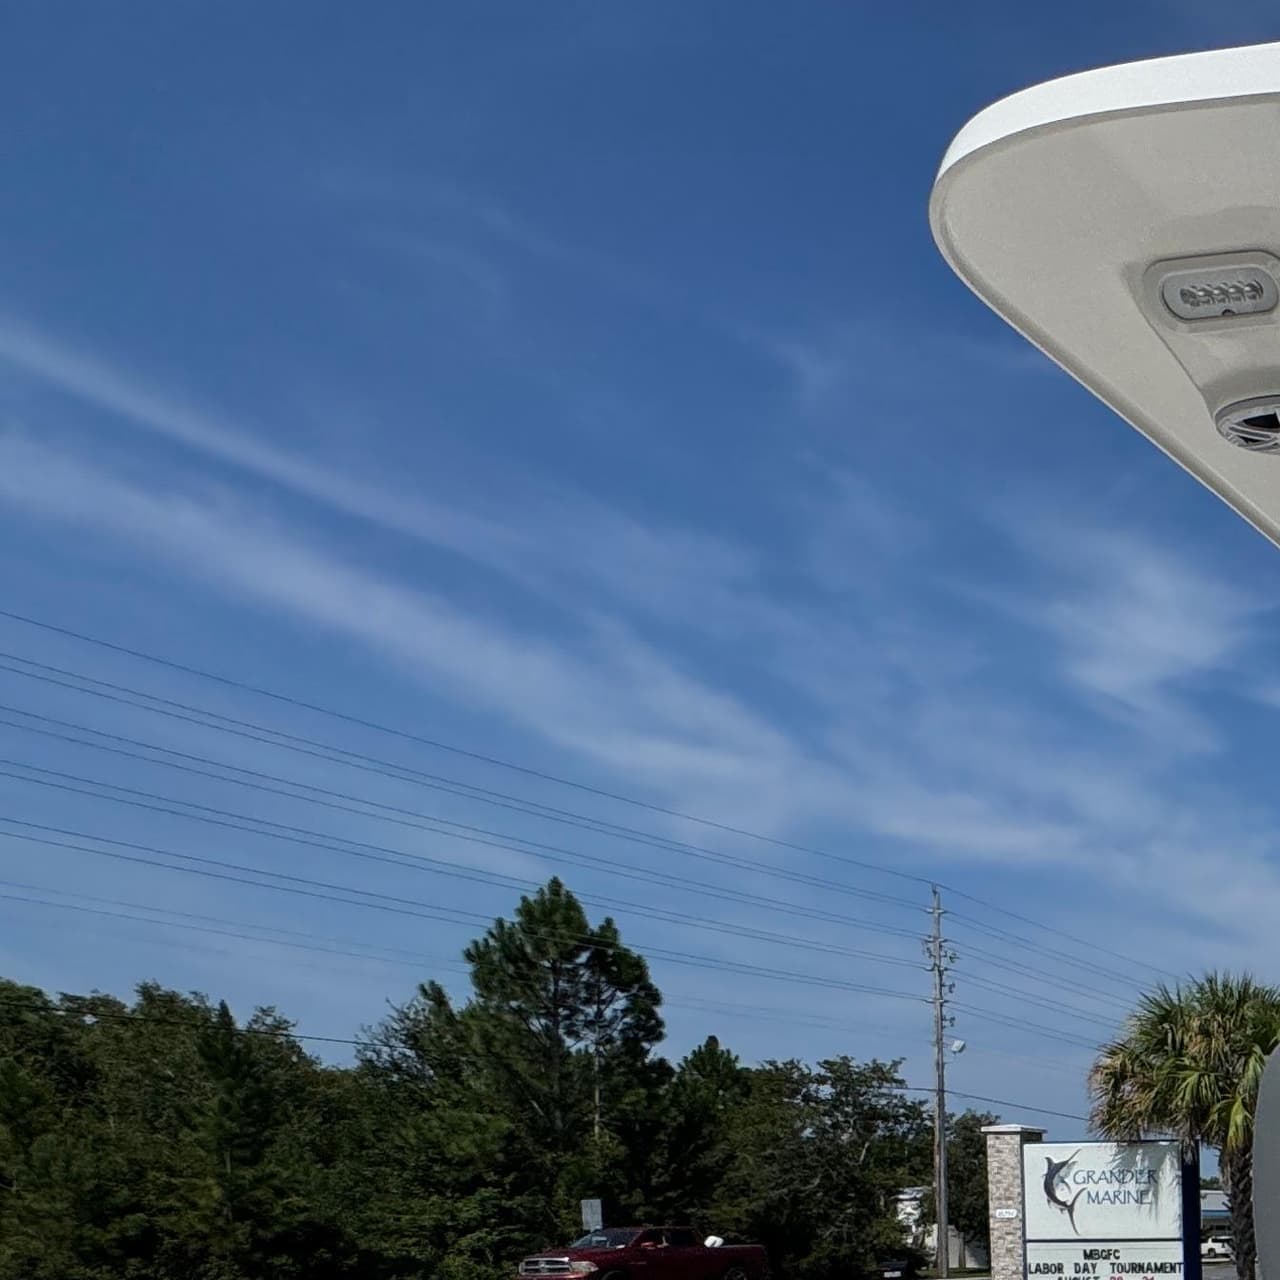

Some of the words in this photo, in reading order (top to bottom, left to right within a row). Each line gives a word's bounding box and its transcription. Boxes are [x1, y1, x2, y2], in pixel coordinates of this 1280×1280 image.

[1073, 1168, 1159, 1185] GRANDER
[1087, 1189, 1152, 1205] MARINE
[1083, 1249, 1121, 1260] MBGFC
[1028, 1263, 1065, 1275] LABOR
[1074, 1262, 1098, 1274] DAY
[1109, 1262, 1184, 1274] TOURNAMENT
